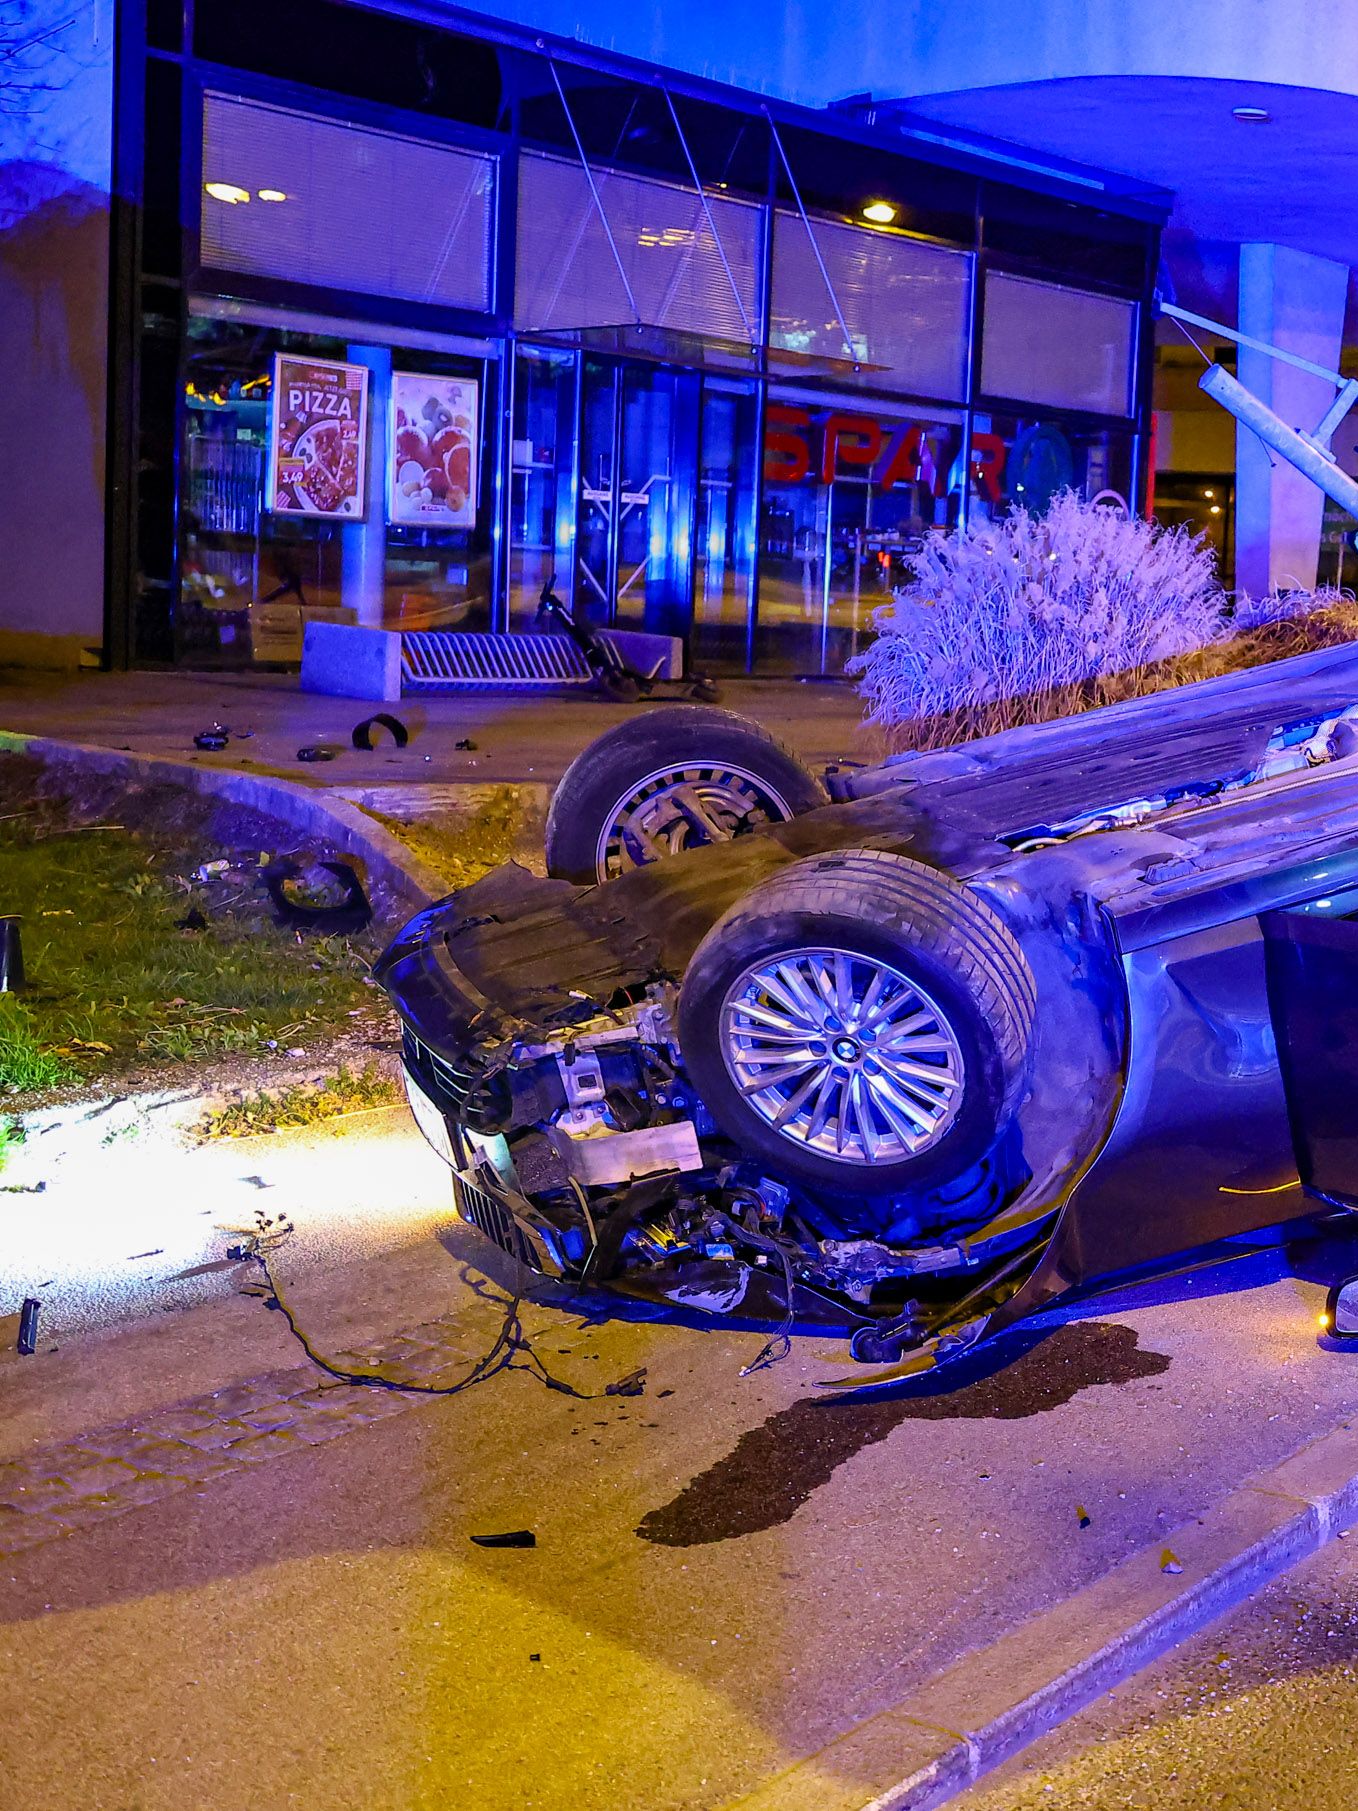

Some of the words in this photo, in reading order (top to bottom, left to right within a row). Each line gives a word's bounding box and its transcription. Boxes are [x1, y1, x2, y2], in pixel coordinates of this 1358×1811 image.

[289, 389, 352, 419] PIZZA
[765, 405, 1006, 504] SPAR
[282, 471, 304, 484] 3,49
